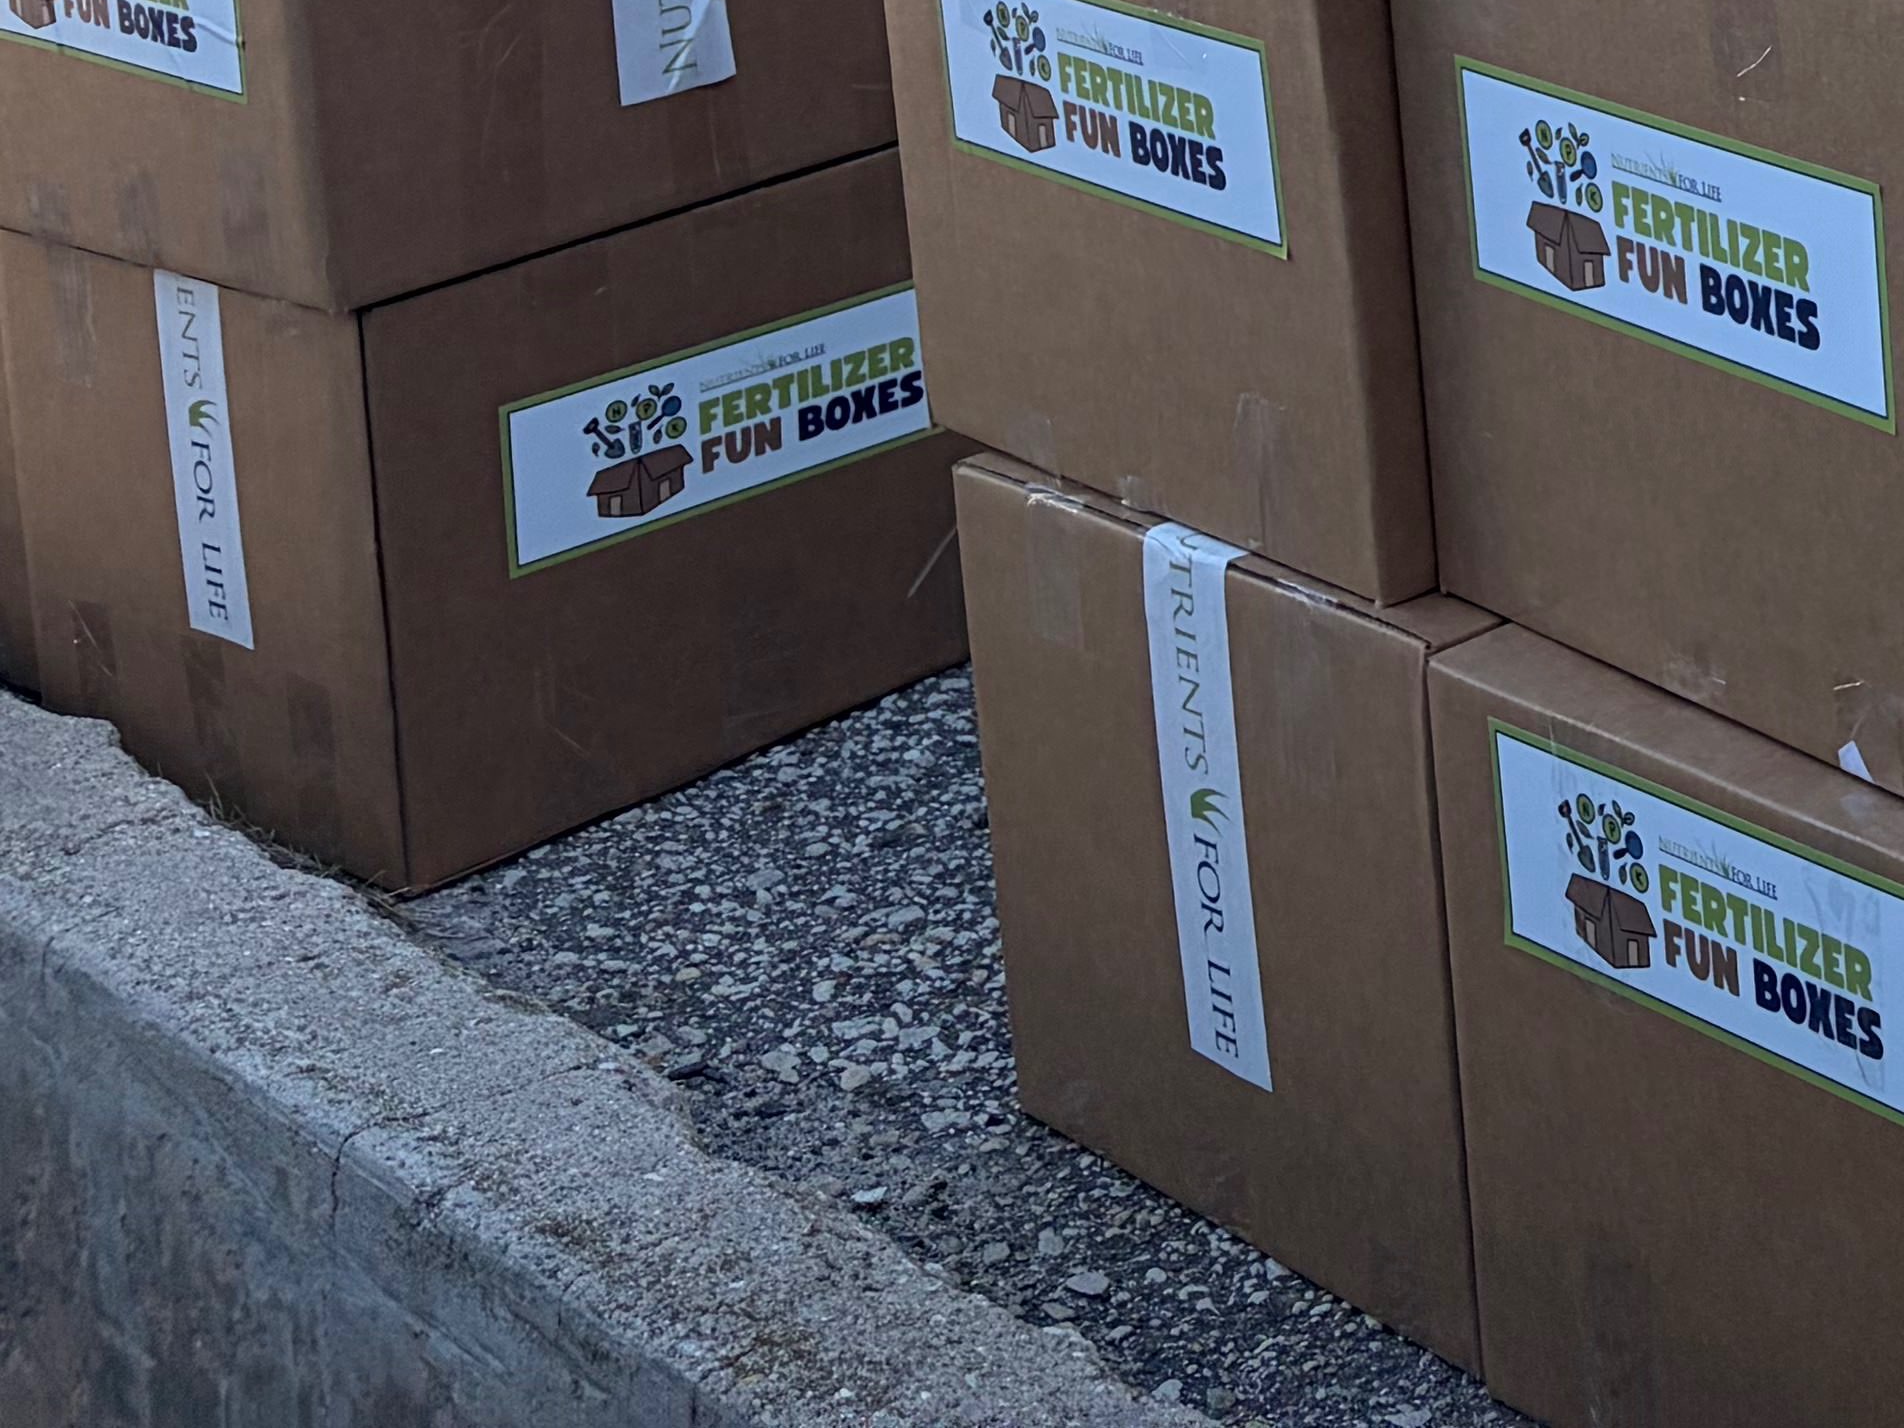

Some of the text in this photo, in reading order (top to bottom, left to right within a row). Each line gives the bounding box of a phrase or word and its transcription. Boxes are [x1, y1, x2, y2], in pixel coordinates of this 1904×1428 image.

[1057, 50, 1217, 141] FERTILIZER
[1062, 99, 1227, 191] FUN BOXES
[1611, 180, 1810, 293] FERTILIZER
[1678, 172, 1700, 195] FOR
[1701, 180, 1722, 202] LIFE
[1616, 235, 1821, 351] FUN BOXES
[698, 336, 917, 435] FERTILIZER
[778, 351, 802, 367] FOR
[804, 343, 827, 360] LIFE
[175, 284, 229, 623] ENTS FOR LIFE
[700, 370, 925, 475] FUN BOXES
[1167, 532, 1239, 1060] UTRIENTS FOR LIFE
[1658, 863, 1873, 1002] FERTILIZER
[1730, 865, 1754, 887] FOR
[1756, 876, 1778, 899] LIFE
[1662, 918, 1884, 1061] FUN BOXES
